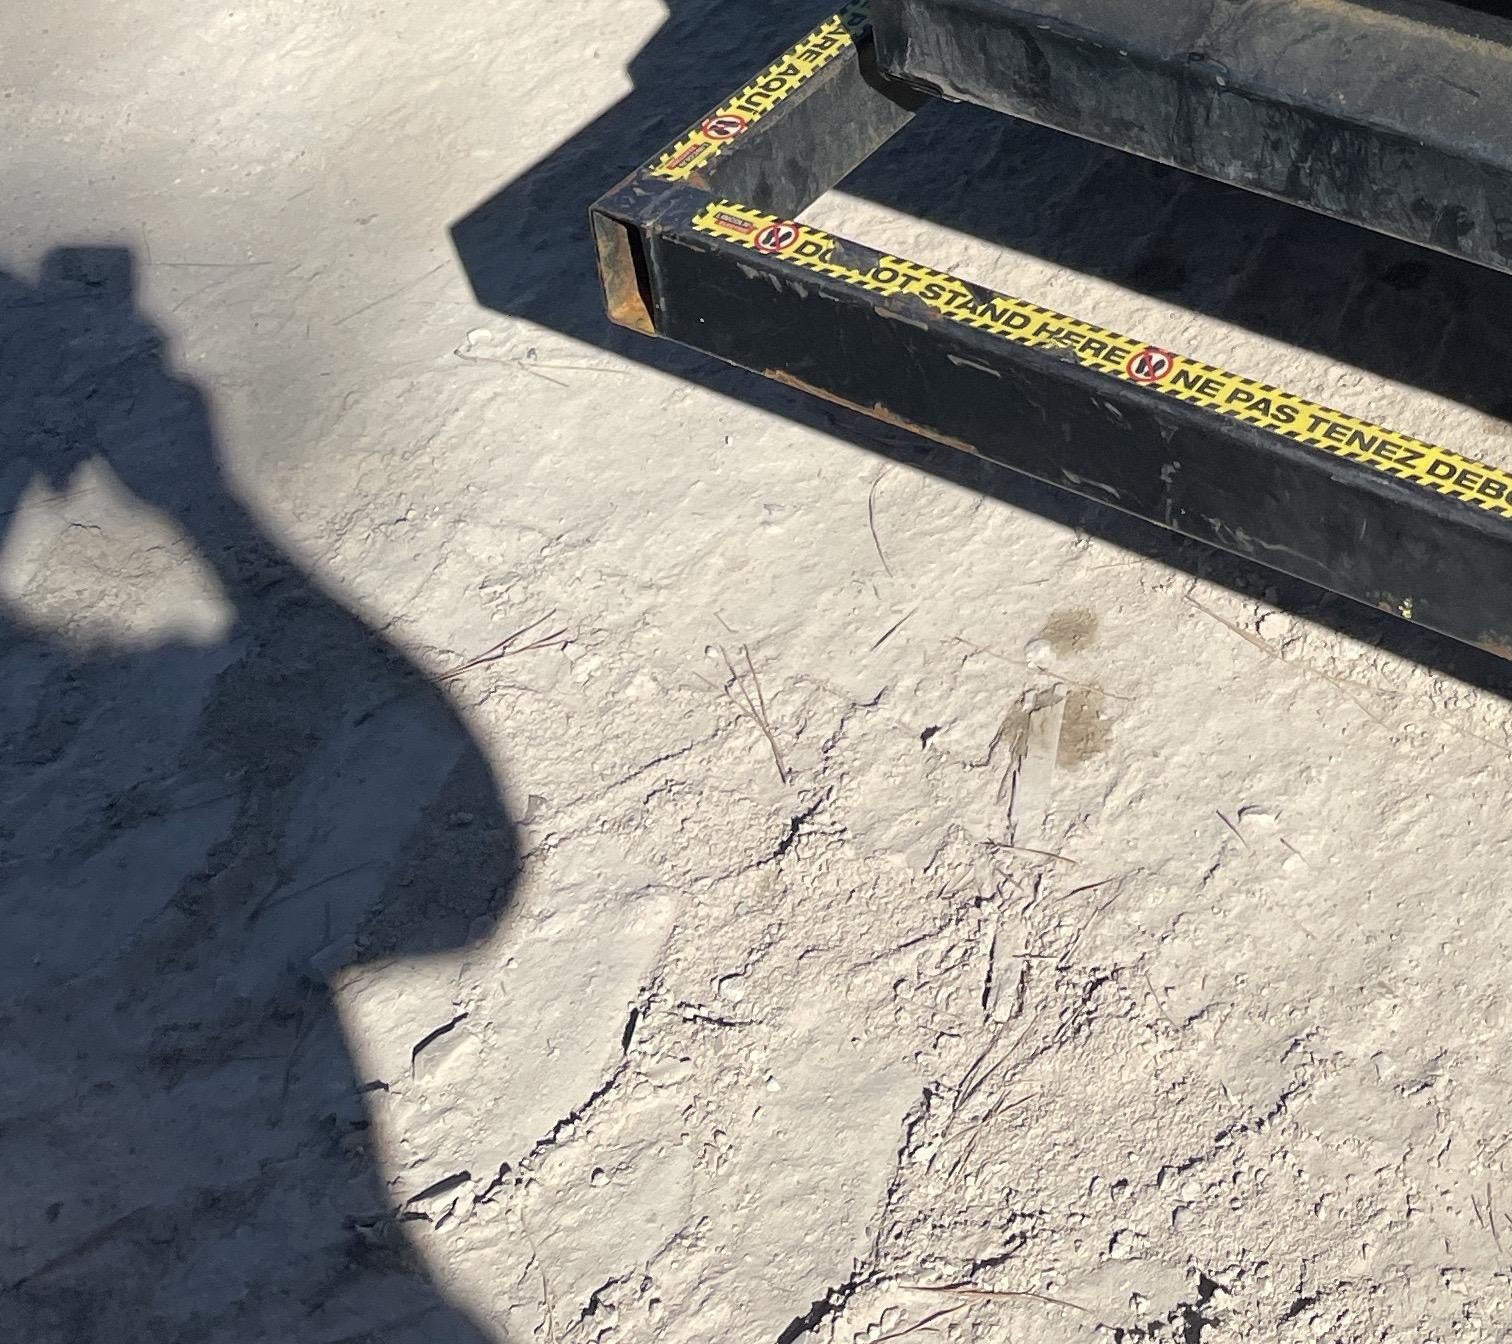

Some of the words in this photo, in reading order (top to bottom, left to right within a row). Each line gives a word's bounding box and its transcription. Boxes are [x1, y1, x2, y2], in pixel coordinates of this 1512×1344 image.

[919, 281, 1031, 334] STAND
[1036, 319, 1131, 366] HERE
[1169, 368, 1223, 400] NE
[1226, 385, 1299, 425] PAS
[1307, 414, 1424, 470] TENEZ
